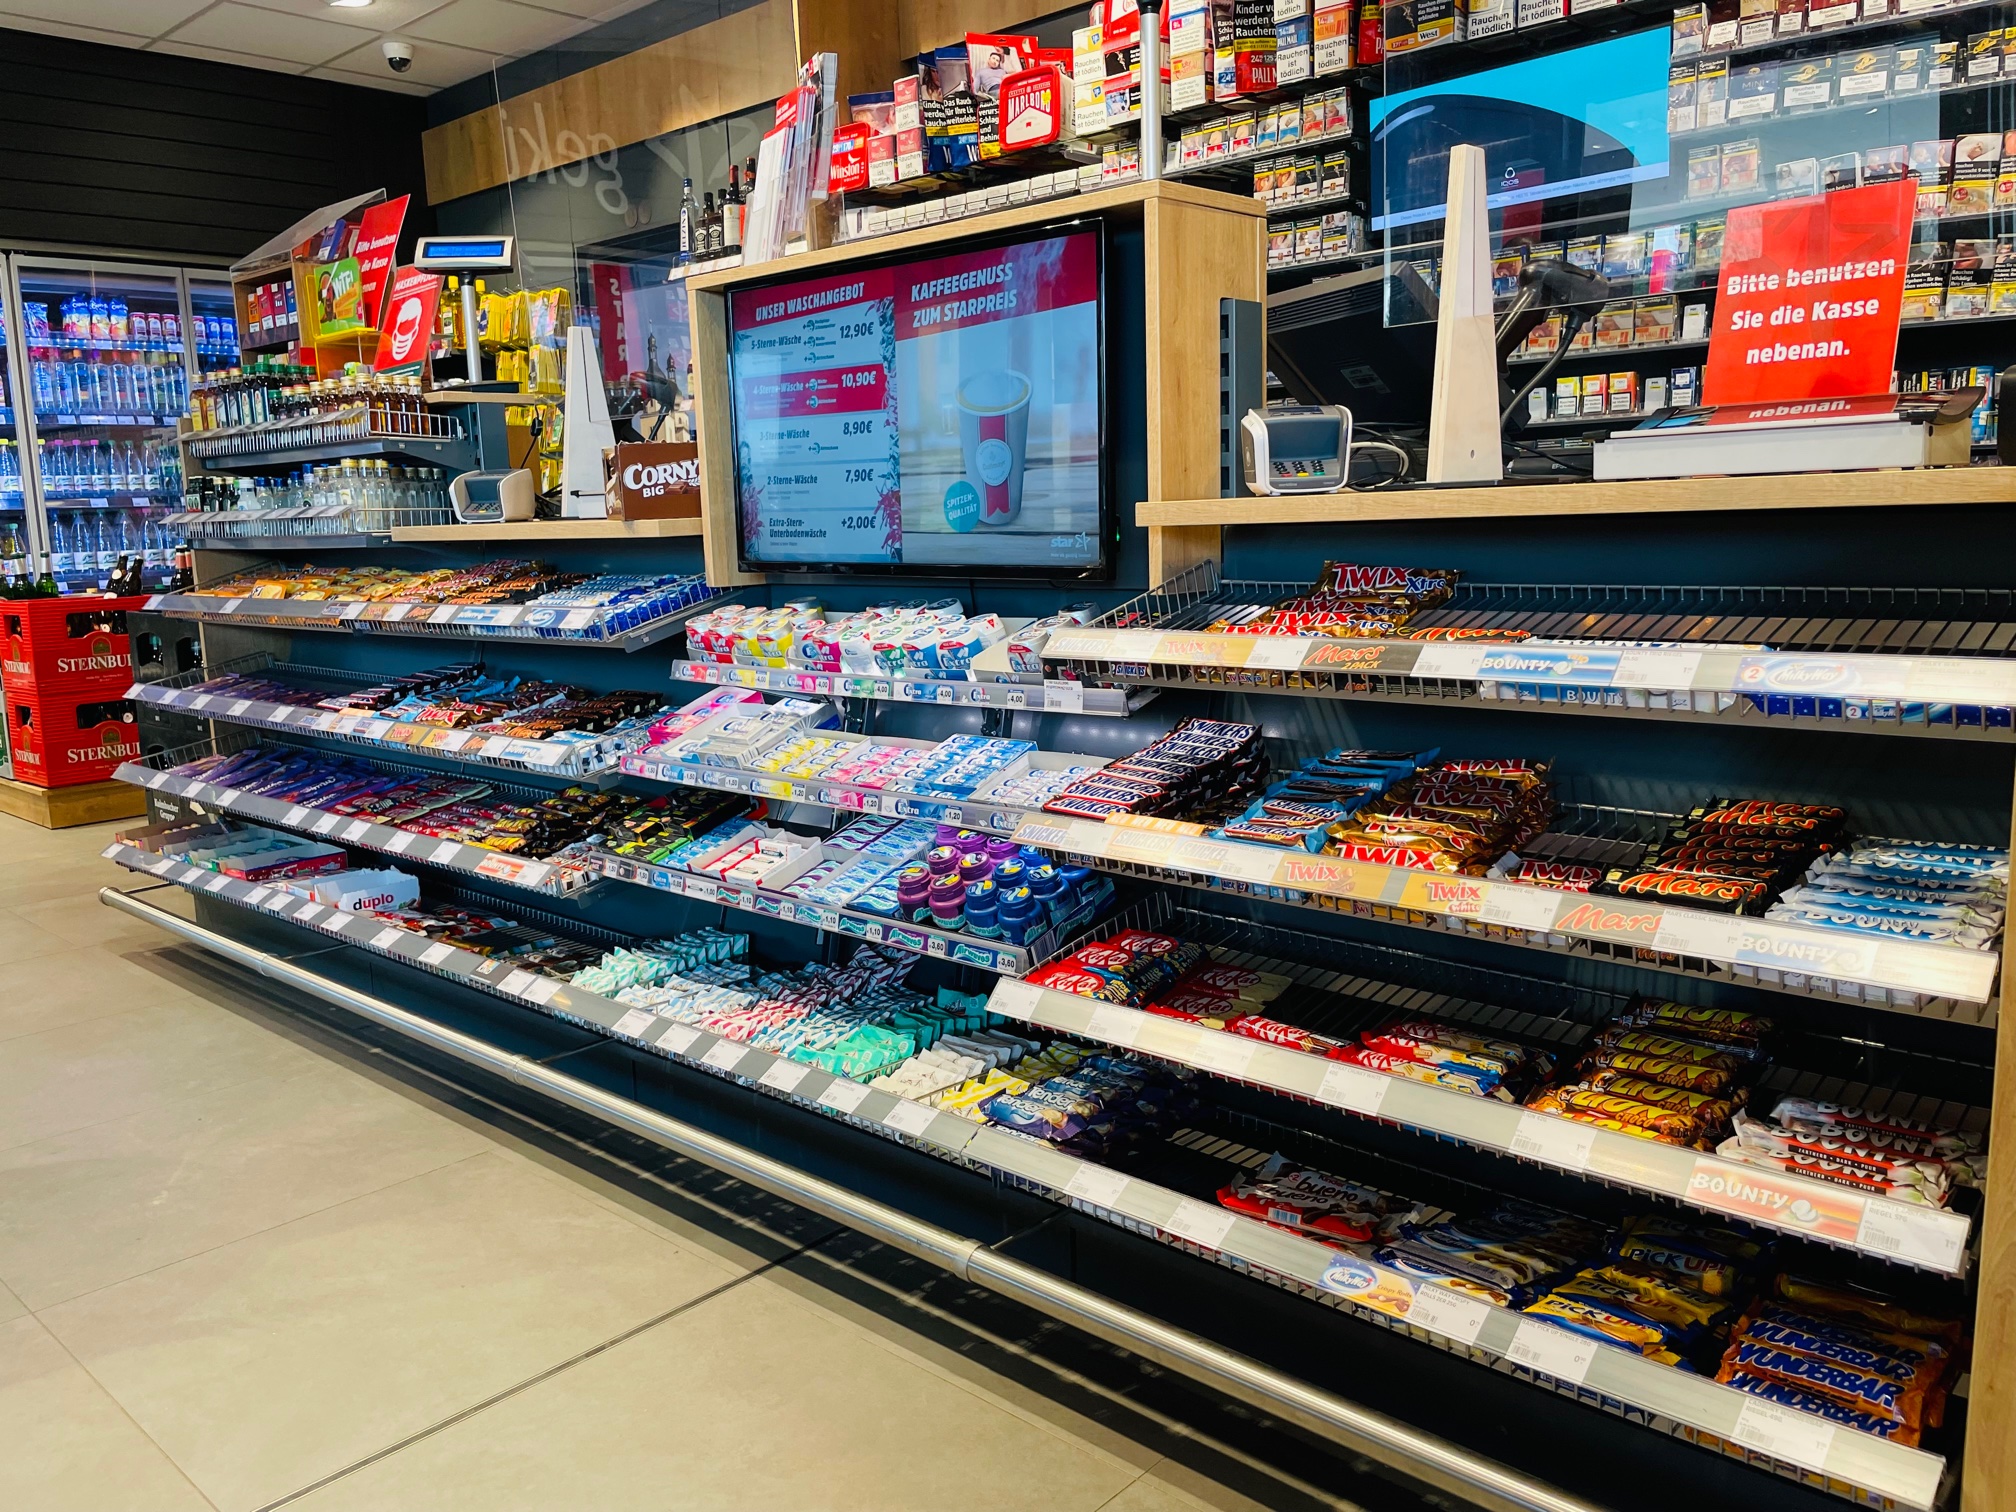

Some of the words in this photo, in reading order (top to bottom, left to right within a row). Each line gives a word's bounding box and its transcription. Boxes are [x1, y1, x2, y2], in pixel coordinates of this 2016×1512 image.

[1236, 4, 1265, 15] Kinder
[1277, 5, 1301, 17] tödlich
[1520, 0, 1560, 13] Rauchen
[1531, 6, 1562, 21] tödlich
[1235, 16, 1269, 26] werden
[1471, 12, 1510, 27] Rauchen
[1481, 21, 1512, 35] tödlich
[1746, 22, 1769, 31] Rauchen
[1219, 34, 1230, 42] und
[1419, 29, 1438, 40] West
[1315, 38, 1348, 52] Rauchen
[1325, 49, 1336, 59] ist
[1277, 49, 1309, 61] Rauchen
[1287, 60, 1297, 68] ist
[1318, 57, 1344, 70] tödlich
[1252, 67, 1272, 85] PALL
[1280, 67, 1305, 79] tödlich
[1077, 109, 1104, 120] Rauchen
[980, 125, 992, 133] und
[830, 163, 860, 180] Winston
[1500, 178, 1521, 189] IQOS
[361, 260, 371, 272] die
[371, 256, 389, 270] Kasse
[911, 262, 1013, 303] KAFFEEGENUSS
[1726, 273, 1780, 296] Bitte
[1786, 258, 1896, 289] benutzen
[755, 302, 785, 322] UNSER
[786, 282, 865, 315] WASCHANGEBOT
[912, 307, 941, 328] ZUM
[943, 289, 1017, 323] STARPREIS
[1730, 310, 1764, 331] Sie
[1769, 306, 1805, 326] die
[1811, 298, 1880, 322] Kasse
[751, 334, 802, 350] 5-Sterne-Wäsche
[839, 321, 875, 341] 12,90€
[1745, 340, 1851, 365] nebenan.
[841, 370, 877, 389] 10,90€
[842, 420, 873, 438] 8,90€
[622, 457, 700, 490] CORNY
[767, 474, 818, 486] 2-Sterne-Wäsche
[845, 468, 874, 485] 7,90€
[643, 484, 665, 498] BIG
[946, 493, 975, 509] SPITZEN-
[948, 504, 977, 521] QUALITÄT
[841, 515, 877, 531] +2,00€
[769, 528, 827, 538] Unterbodenwäsche
[1051, 536, 1074, 549] star
[1332, 563, 1410, 592] TWIX
[1405, 575, 1447, 595] Xtra
[1271, 610, 1353, 627] TWIX
[1165, 639, 1206, 655] Twix
[1303, 643, 1386, 666] Mars
[1480, 657, 1551, 672] BOUNTY
[1749, 668, 1758, 680] 2
[1777, 667, 1838, 683] MilkyWay
[1186, 718, 1256, 740] SNICKERS
[1171, 732, 1242, 750] SNICKERS
[1068, 783, 1144, 803] SNICKERS
[1090, 775, 1164, 795] SNICKERS
[895, 798, 920, 816] Extra
[1271, 799, 1344, 820] SNICKERS
[1413, 784, 1514, 818] TWIX
[1702, 809, 1819, 830] Mars
[1335, 841, 1438, 871] TWIX
[1284, 861, 1341, 882] Twix
[1427, 881, 1482, 901] Twix
[1617, 872, 1746, 900] Mars
[353, 893, 395, 911] duplo
[1449, 901, 1481, 914] white
[1555, 903, 1663, 933] Mars
[889, 928, 923, 950] Airwaves
[1120, 935, 1174, 954] KitKat
[954, 944, 993, 966] Airwaves
[1076, 947, 1130, 967] KitKat
[1740, 934, 1841, 964] BOUNTY
[1043, 974, 1101, 992] KitKat
[1202, 969, 1262, 988] KitKat
[1173, 995, 1233, 1015] KitKat
[1655, 1001, 1753, 1027] LION
[1701, 1020, 1741, 1033] CHOCO
[1617, 1032, 1720, 1061] LION
[1611, 1052, 1710, 1080] LION
[1655, 1072, 1696, 1089] CHOCO
[1027, 1086, 1077, 1112] Tender
[1607, 1077, 1714, 1107] LION
[996, 1093, 1046, 1114] Tender
[1570, 1090, 1677, 1121] LION
[1656, 1100, 1697, 1117] CHOCO
[1614, 1111, 1655, 1127] CHOCO
[1819, 1122, 1966, 1162] BOUNTY
[1269, 1187, 1331, 1204] bueno
[1295, 1175, 1359, 1202] bueno
[1691, 1173, 1790, 1207] BOUNTY
[1629, 1248, 1683, 1273] PICK
[1683, 1256, 1729, 1277] UP!
[1331, 1271, 1370, 1289] MilkyWay
[1376, 1283, 1397, 1295] Crispy
[1397, 1285, 1412, 1299] Rolls
[1537, 1323, 1550, 1334] PICK
[1550, 1328, 1559, 1337] UP
[1748, 1318, 1917, 1381] WUNDERBAR
[1732, 1342, 1906, 1410] WUNDERBAR
[1726, 1371, 1900, 1438] WUNDERBAR
